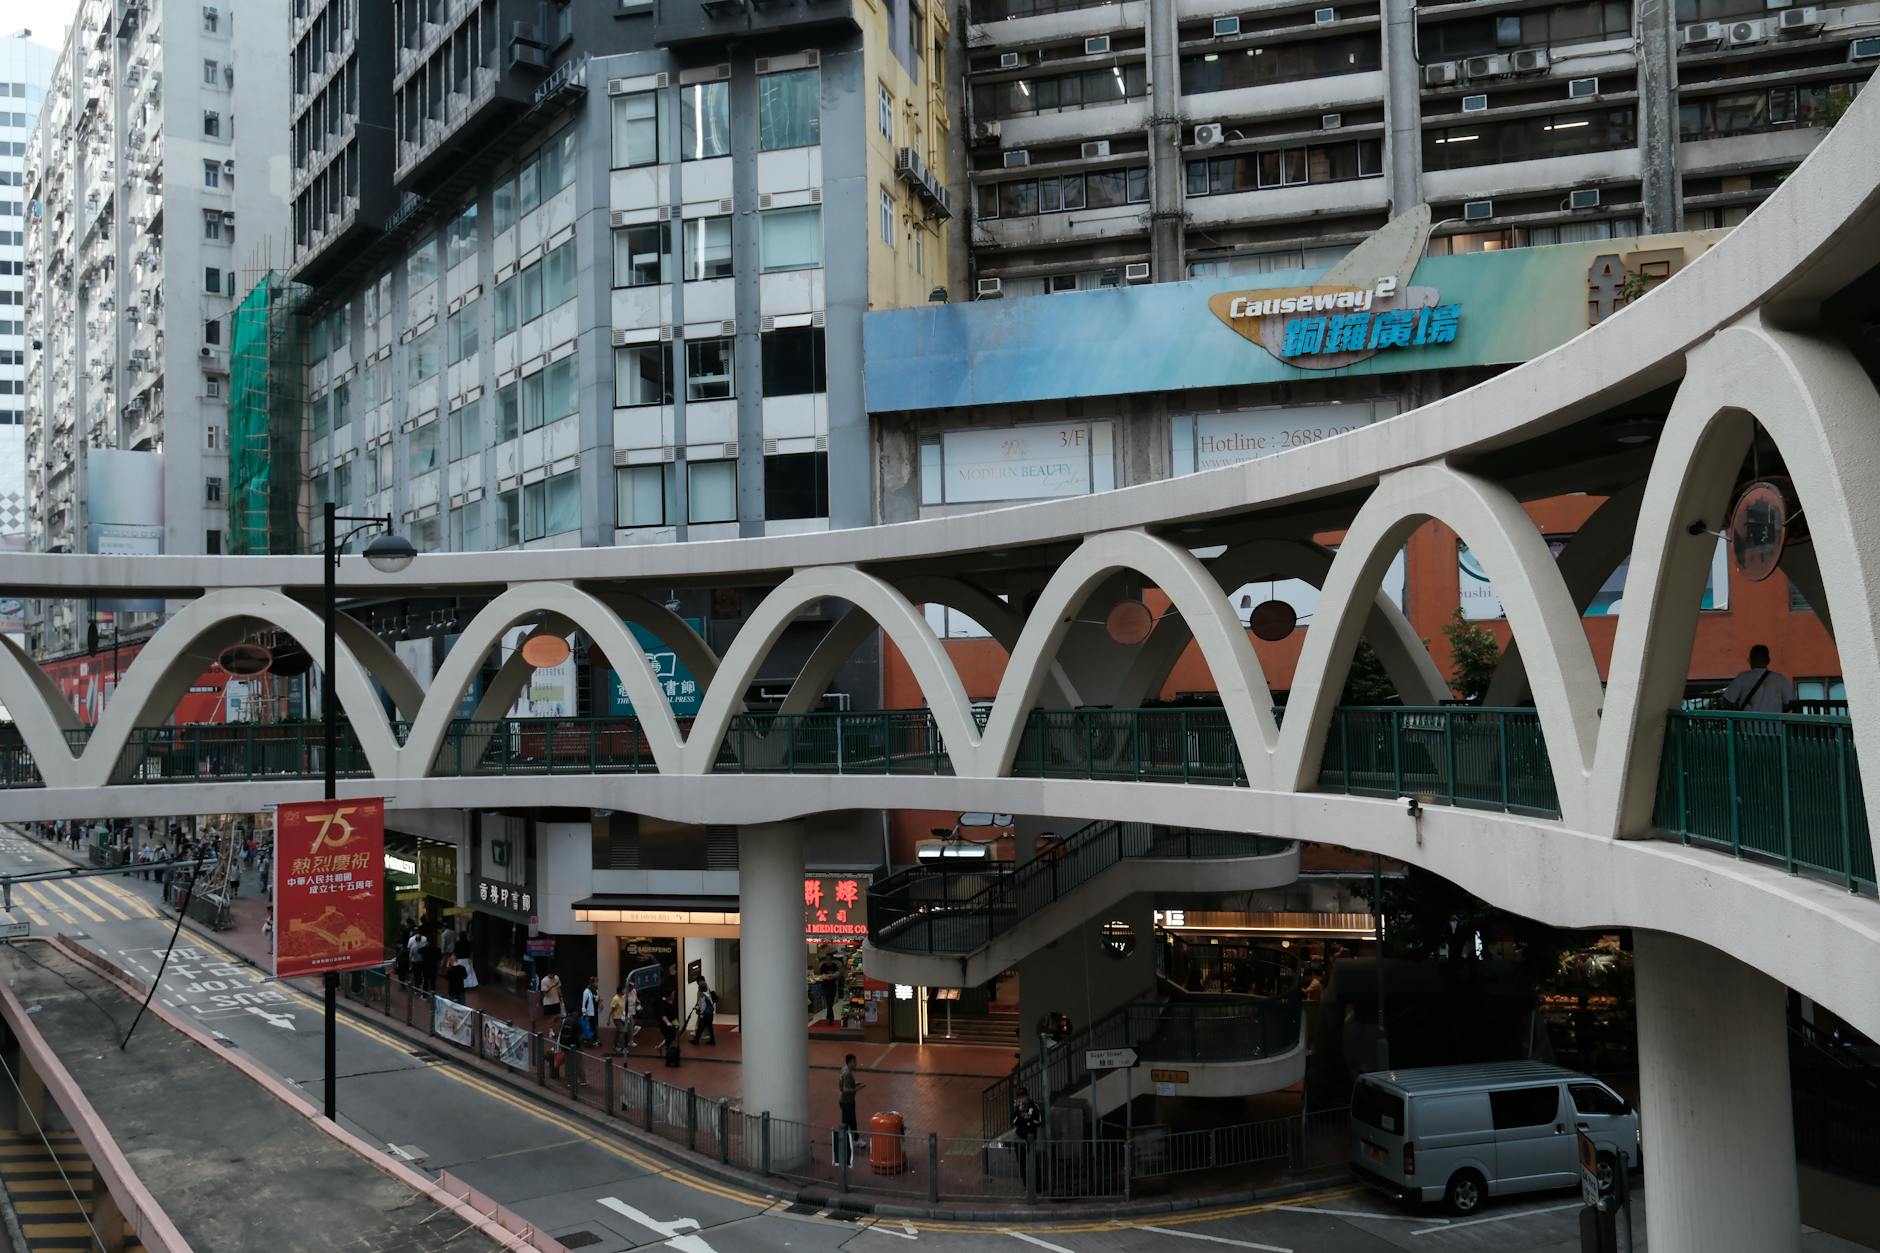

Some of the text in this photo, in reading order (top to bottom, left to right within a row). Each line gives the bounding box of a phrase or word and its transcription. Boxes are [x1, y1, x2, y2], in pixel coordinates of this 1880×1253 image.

[1278, 303, 1462, 357] 銅鑼廣場
[1060, 429, 1085, 448] 3/F
[1200, 432, 1266, 453] Hotline
[959, 463, 1073, 480] MODERN BEAUTY
[305, 807, 358, 855] 75
[291, 852, 370, 875] 熱烈慶祝
[813, 924, 854, 934] MEDICINE
[854, 924, 869, 934] CO.
[209, 991, 288, 1008] BUS
